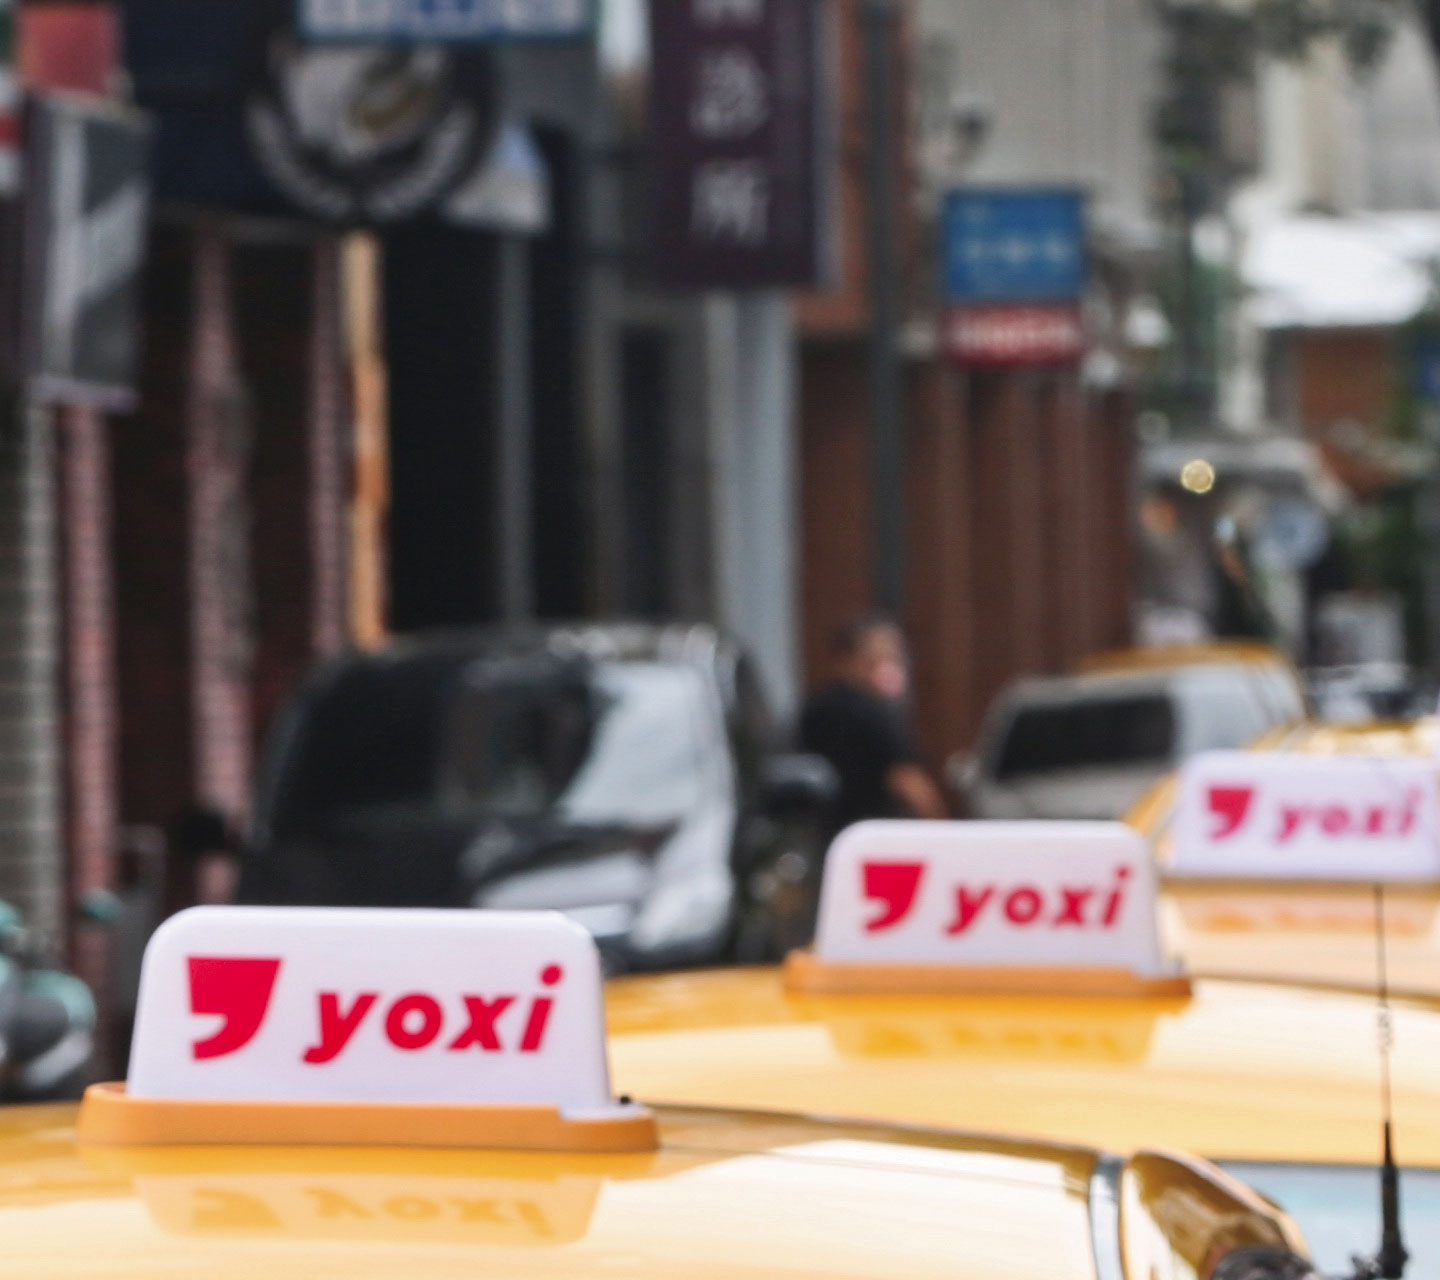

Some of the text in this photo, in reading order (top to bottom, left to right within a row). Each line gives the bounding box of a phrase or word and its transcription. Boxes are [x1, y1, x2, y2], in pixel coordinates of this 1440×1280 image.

[1274, 784, 1425, 844] yoxi
[944, 865, 1131, 937] yoxi
[300, 963, 565, 1065] yoxi
